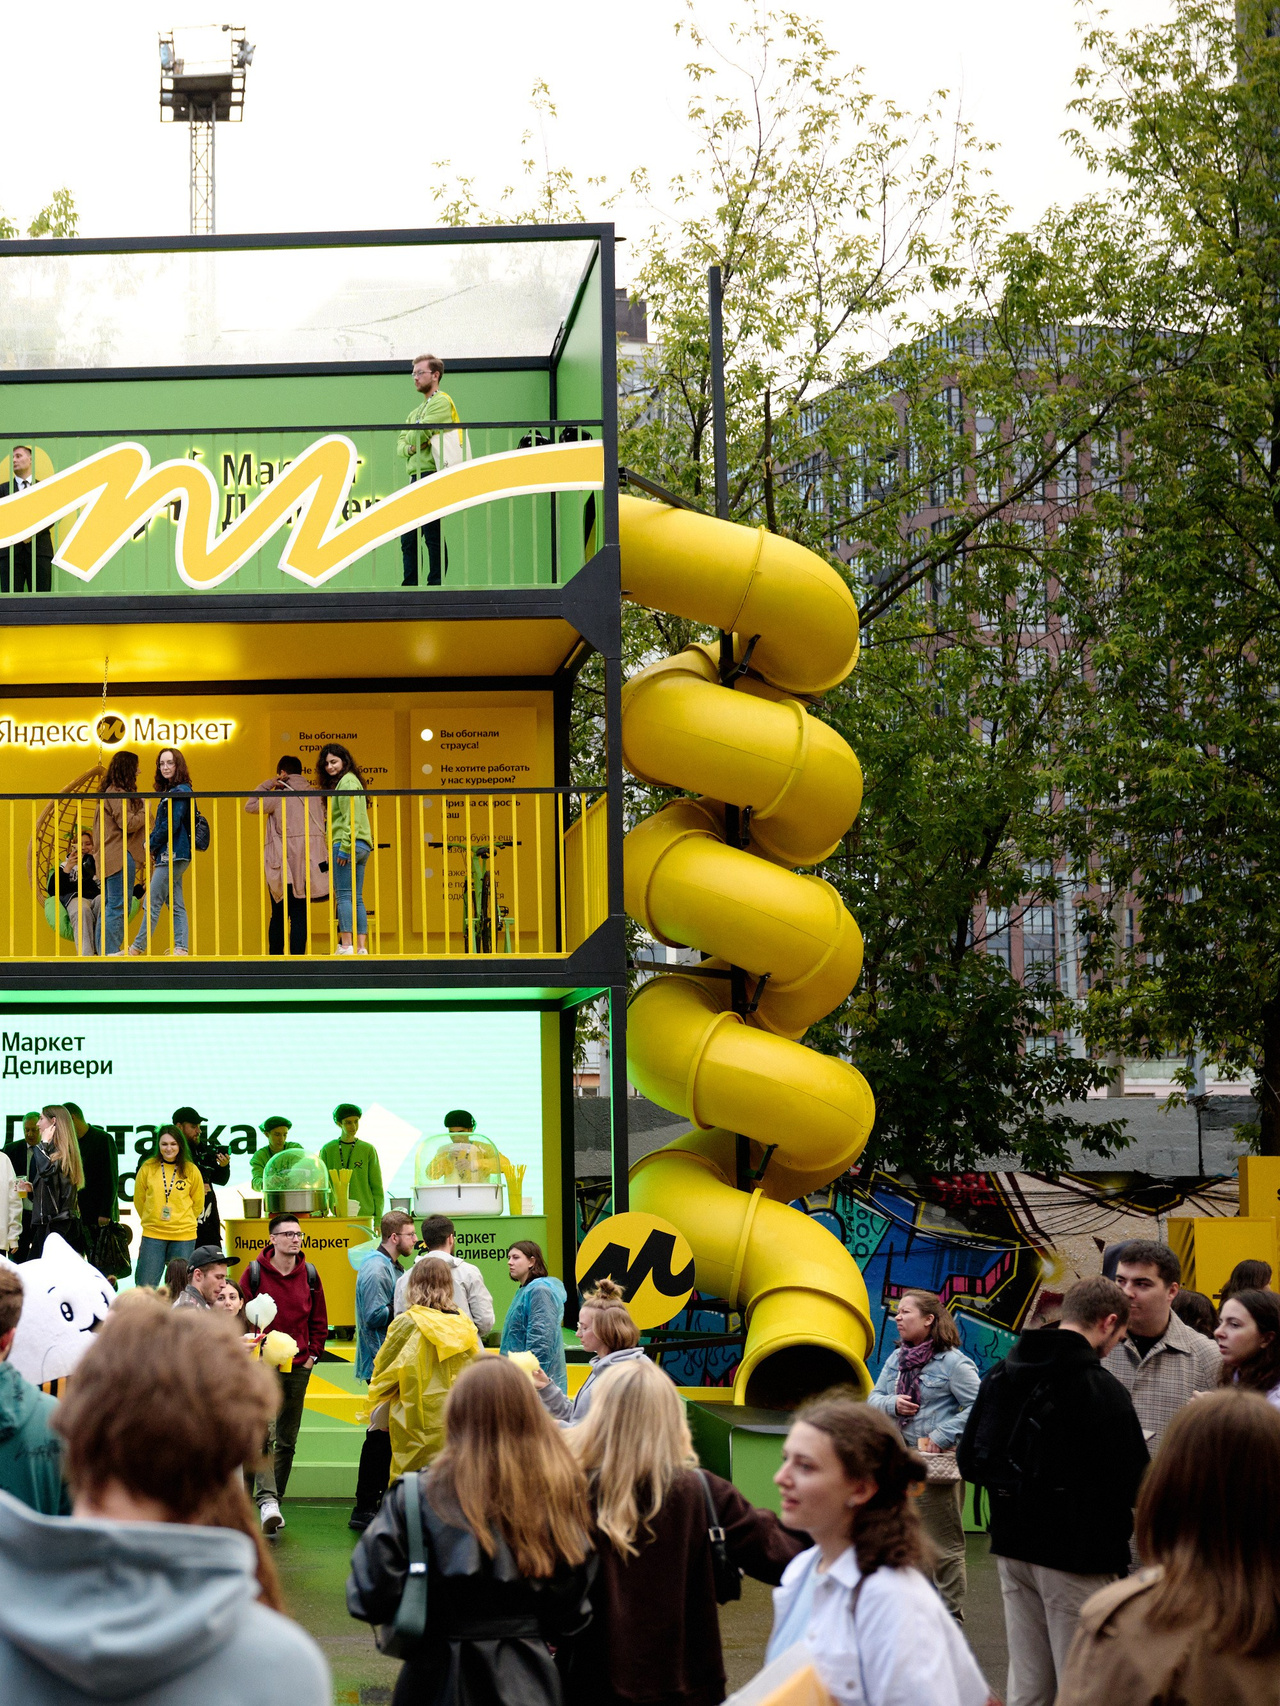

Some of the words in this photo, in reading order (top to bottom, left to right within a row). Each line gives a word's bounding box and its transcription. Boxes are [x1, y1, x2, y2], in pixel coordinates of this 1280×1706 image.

[134, 718, 233, 745] Маркет
[299, 731, 313, 740] Вы
[314, 731, 358, 740] обогнали
[440, 729, 454, 738] Вы
[455, 729, 500, 738] обогнали
[440, 741, 479, 751] страуса!
[440, 764, 454, 773] Не
[455, 764, 486, 773] хотите
[487, 763, 530, 774] работать
[440, 777, 447, 786] у
[447, 776, 464, 784] нас
[465, 775, 516, 786] курьером?
[2, 1031, 86, 1055] Маркет
[2, 1055, 113, 1079] Деливери
[235, 1236, 271, 1250] Яндек
[300, 1236, 350, 1250] Маркет
[454, 1231, 497, 1246] аркет
